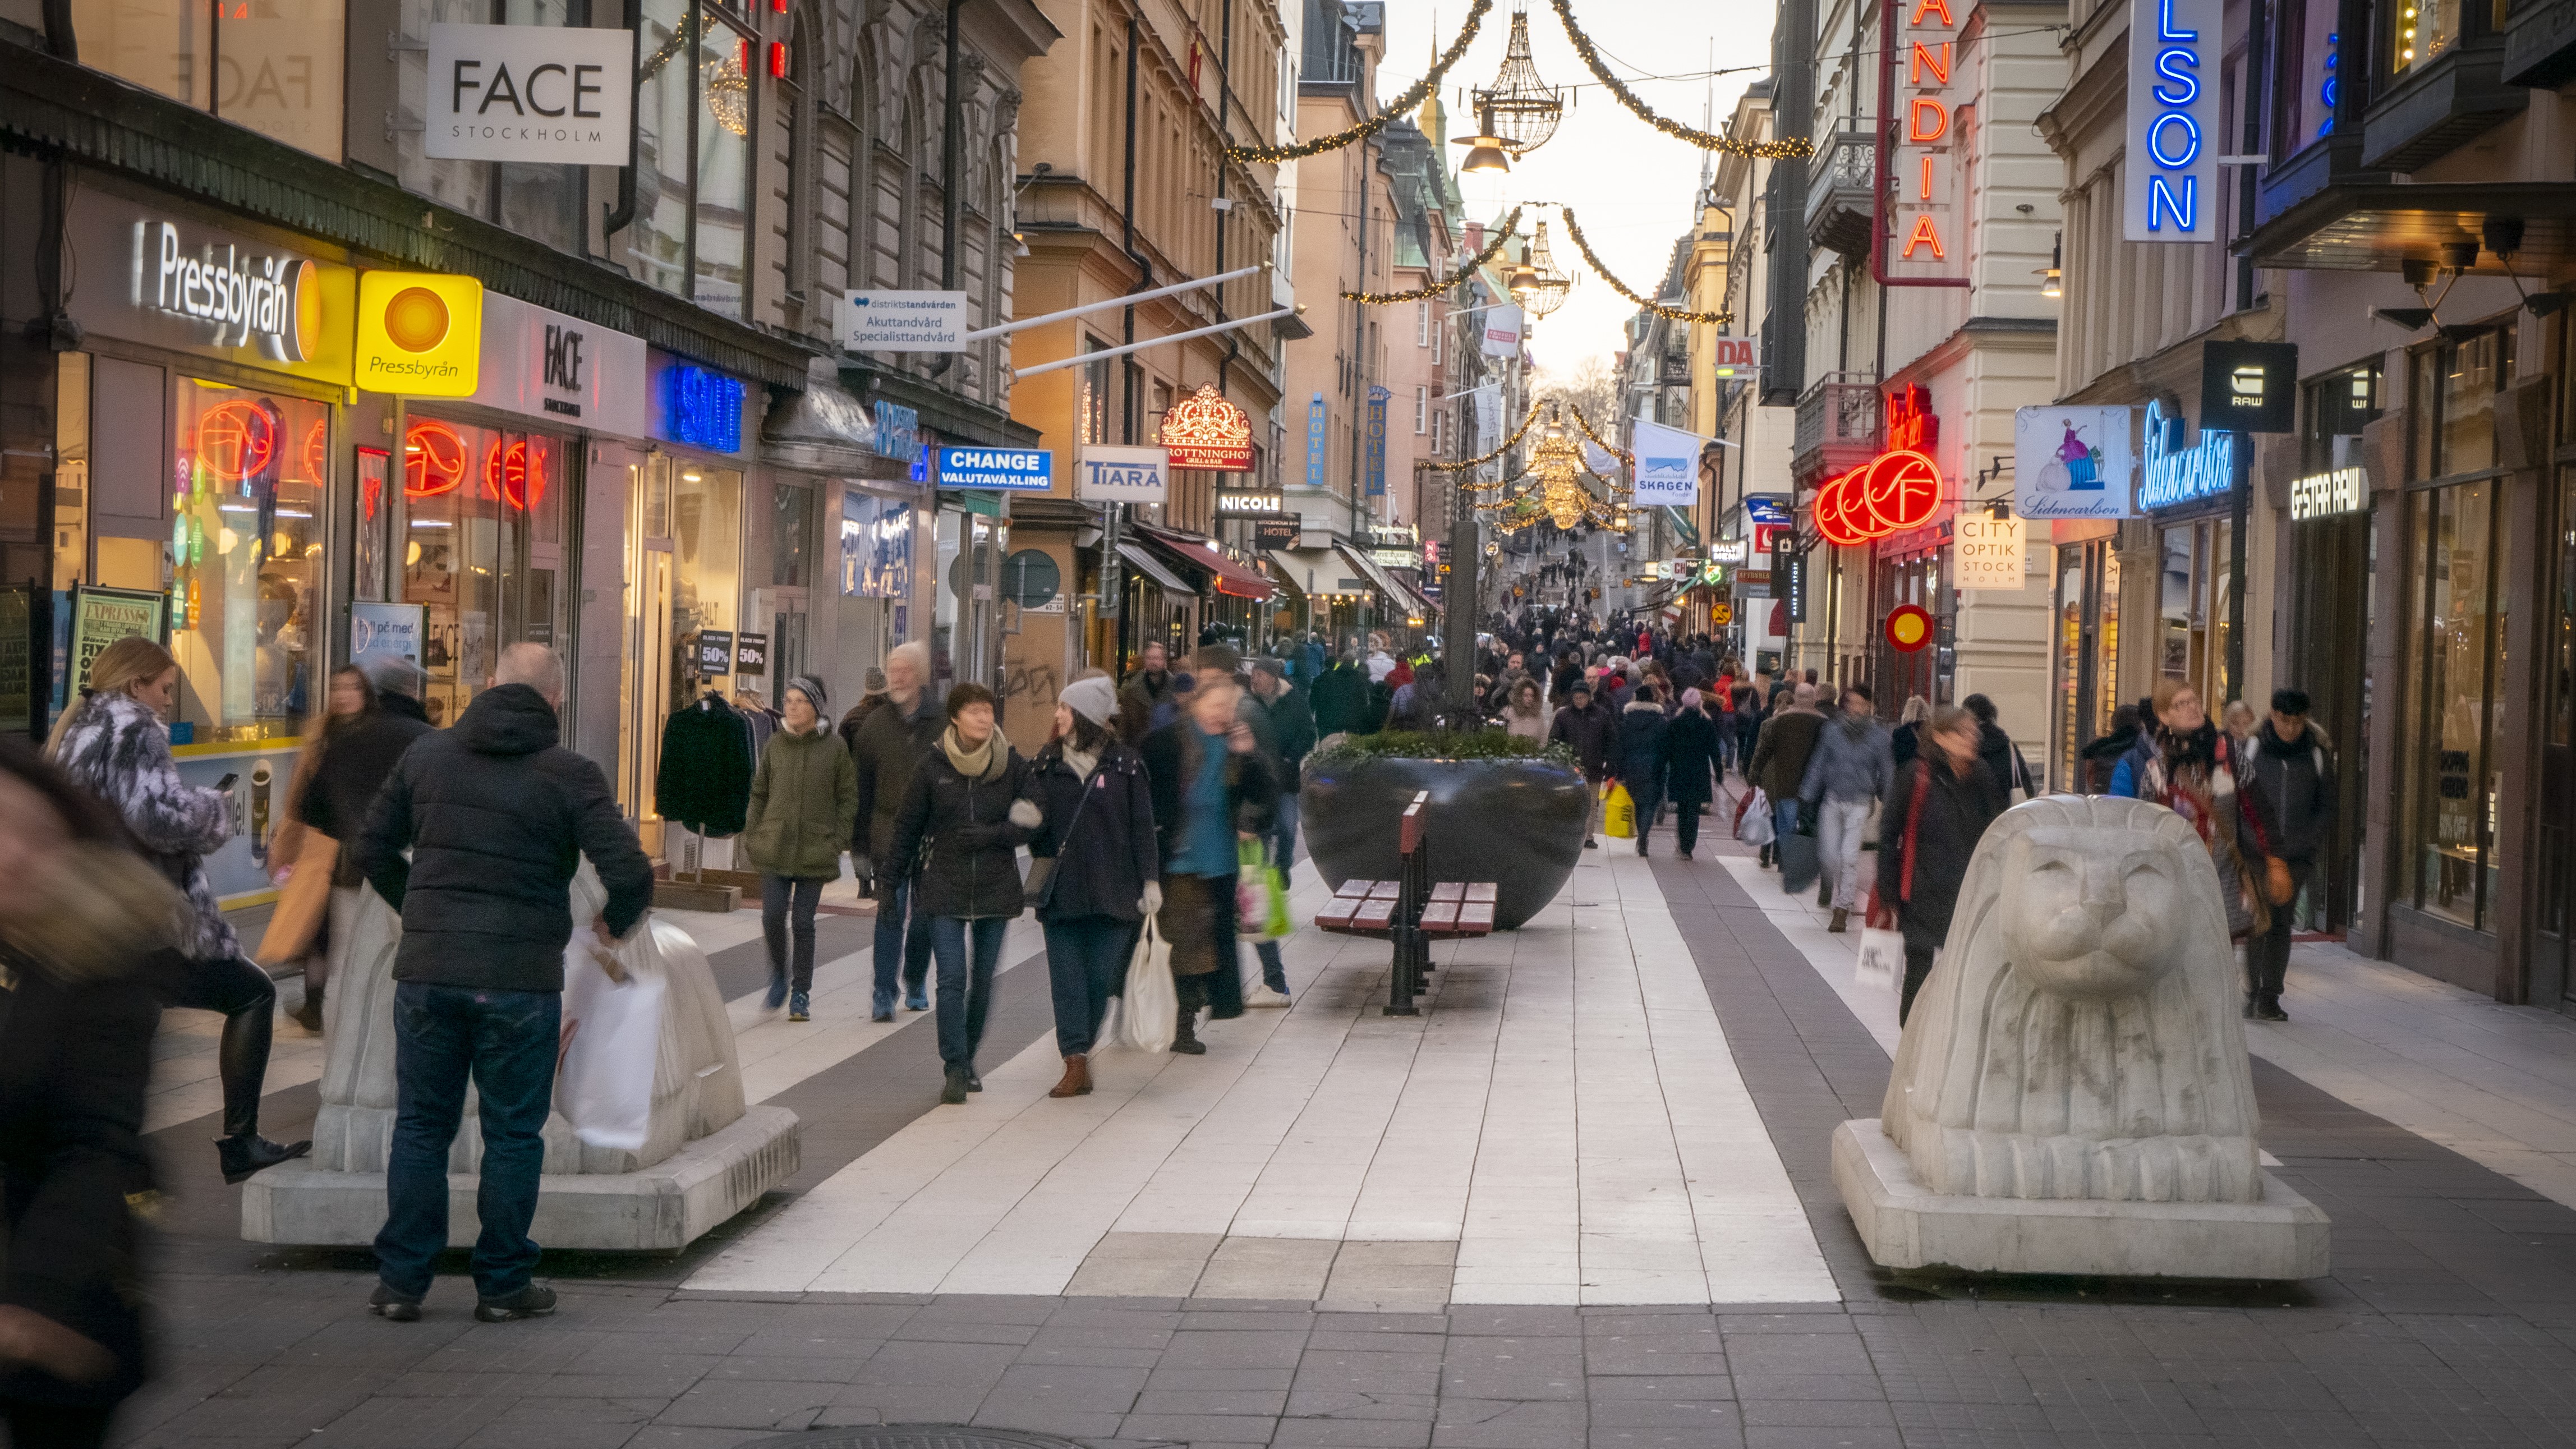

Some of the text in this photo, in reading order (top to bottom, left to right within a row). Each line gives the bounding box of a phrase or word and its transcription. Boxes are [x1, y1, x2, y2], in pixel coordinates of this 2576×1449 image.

[452, 59, 602, 118] FACE
[2146, 0, 2201, 232] LSON
[452, 125, 601, 142] STOCKHOLM
[1901, 0, 1952, 257] ANDIA
[158, 222, 288, 348] Pressbyrån
[871, 300, 956, 309] distriktstandvården
[866, 316, 942, 328] Akuttandvård
[853, 330, 955, 343] Specialisttandvård
[544, 324, 583, 392] FACE
[1718, 340, 1754, 366] DA
[369, 355, 459, 380] Pressbyrån
[2232, 396, 2264, 406] RAW
[1310, 406, 1323, 480] HOTEL
[1368, 405, 1384, 490] HOTEL
[950, 451, 1040, 471] CHANGE
[1169, 447, 1252, 460] ROTTNINGHOF
[941, 472, 1049, 486] VALUTAVÄXLING
[1639, 480, 1693, 491] SKAGEN
[2292, 467, 2359, 521] G-STAR RAW
[1221, 496, 1281, 511] NICOLE
[2021, 495, 2120, 516] Sidencarlson
[1264, 527, 1293, 537] HOTEL
[1962, 522, 2018, 538] CITY
[1962, 543, 2016, 556] OPTIK
[1963, 562, 2015, 572] STOCK
[393, 622, 414, 634] med
[702, 646, 729, 663] 50%
[739, 647, 763, 664] 50%
